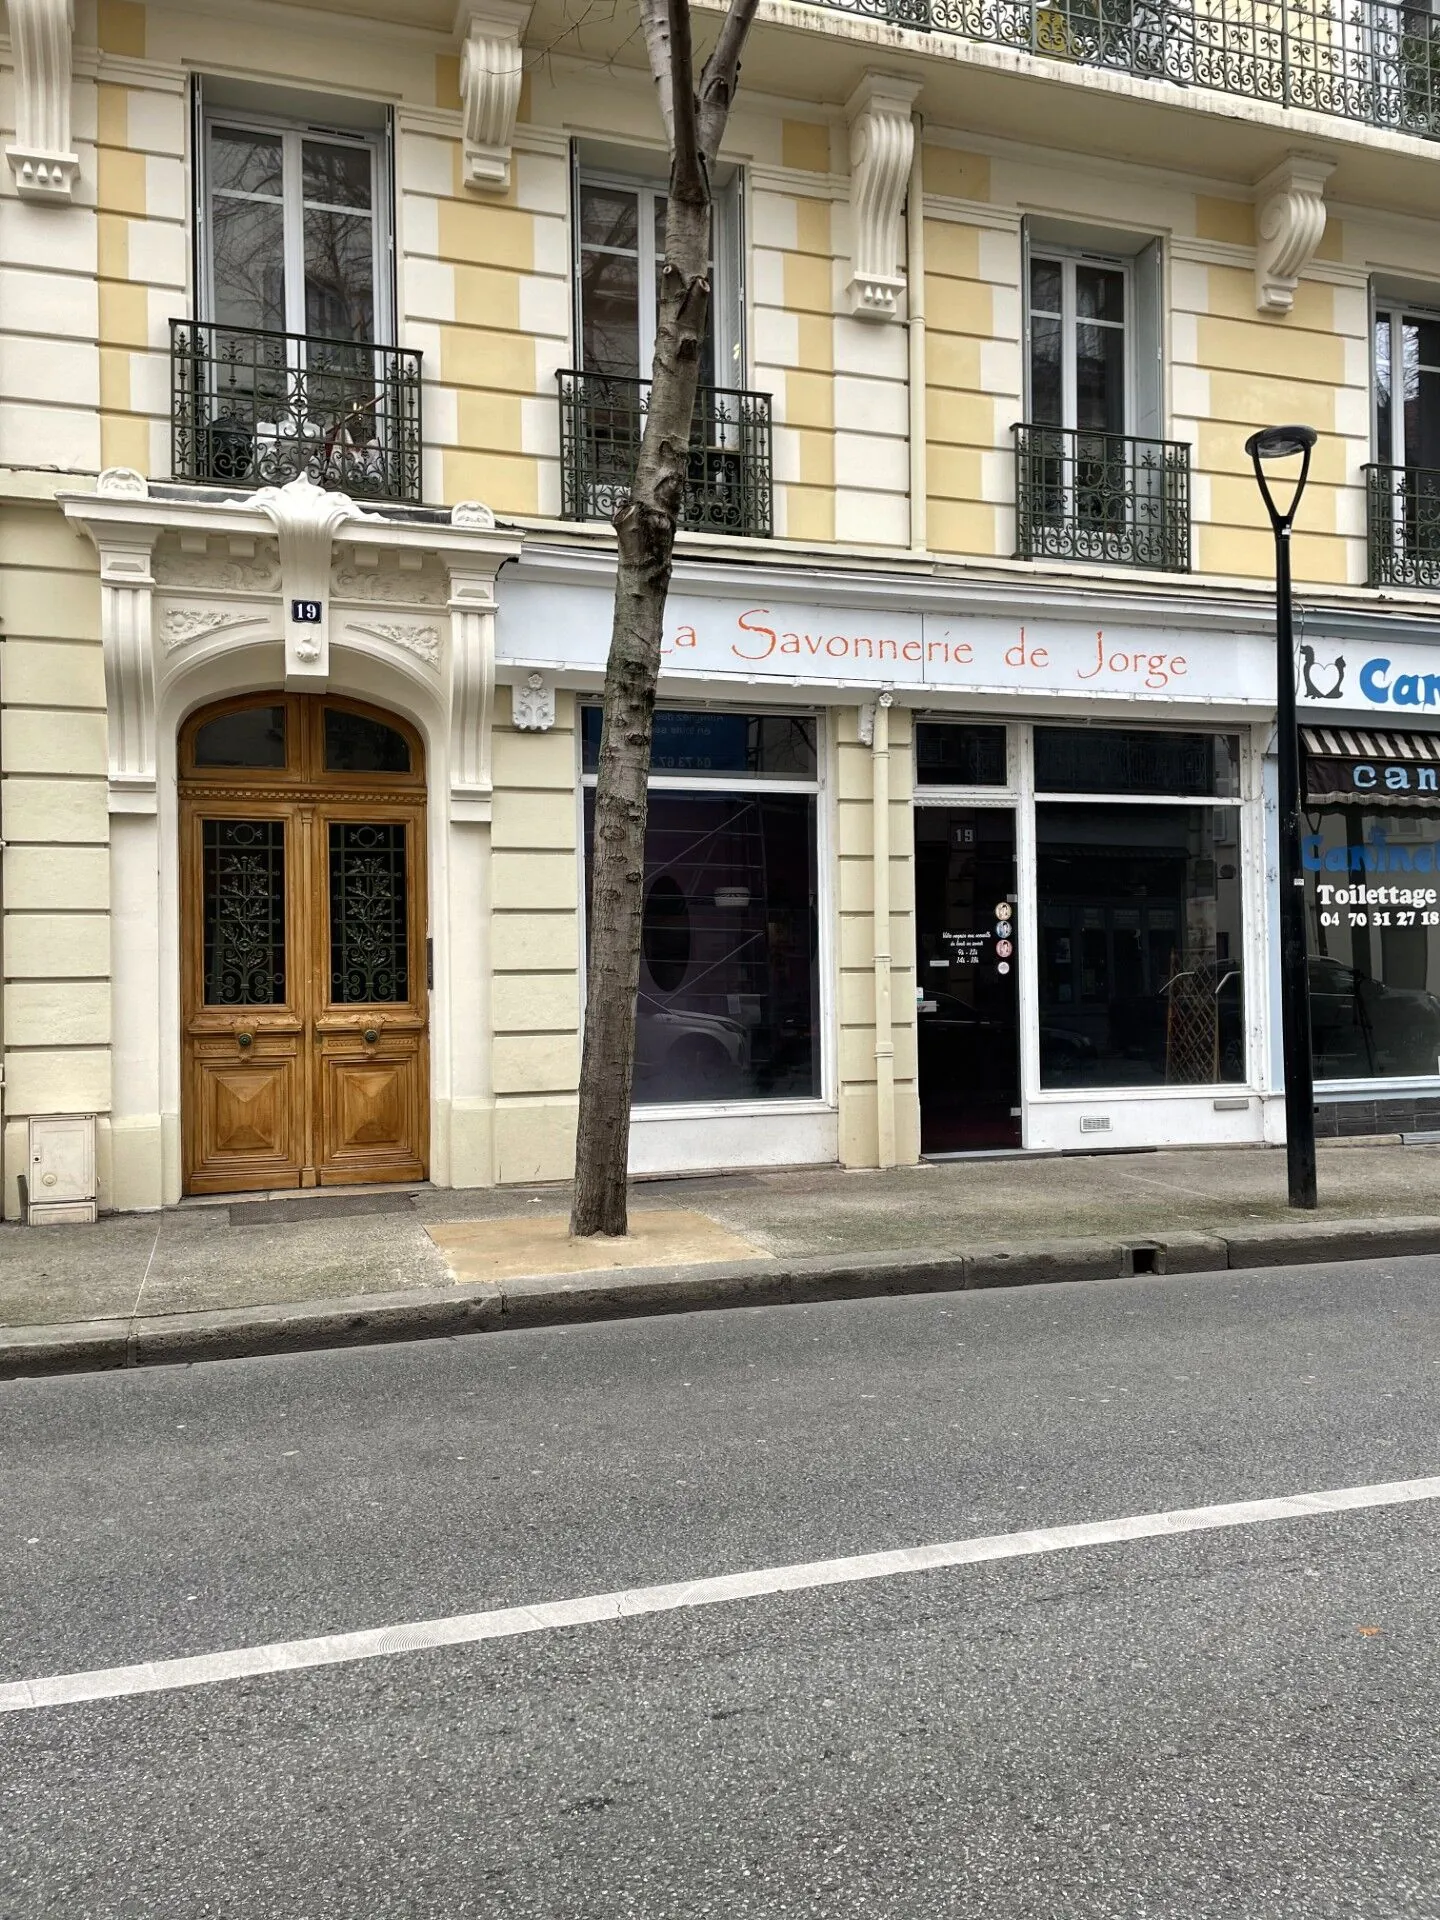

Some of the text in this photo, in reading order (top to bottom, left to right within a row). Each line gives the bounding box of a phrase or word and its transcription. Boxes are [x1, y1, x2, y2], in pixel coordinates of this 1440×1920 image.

[297, 603, 317, 619] 19
[732, 609, 974, 662] Savonnerie
[1004, 626, 1049, 668] de
[1076, 630, 1188, 689] Jorge
[1353, 765, 1439, 790] can
[956, 829, 974, 842] 19
[1316, 884, 1437, 908] Toilettage
[1320, 911, 1440, 927] 04 70 31 27 18
